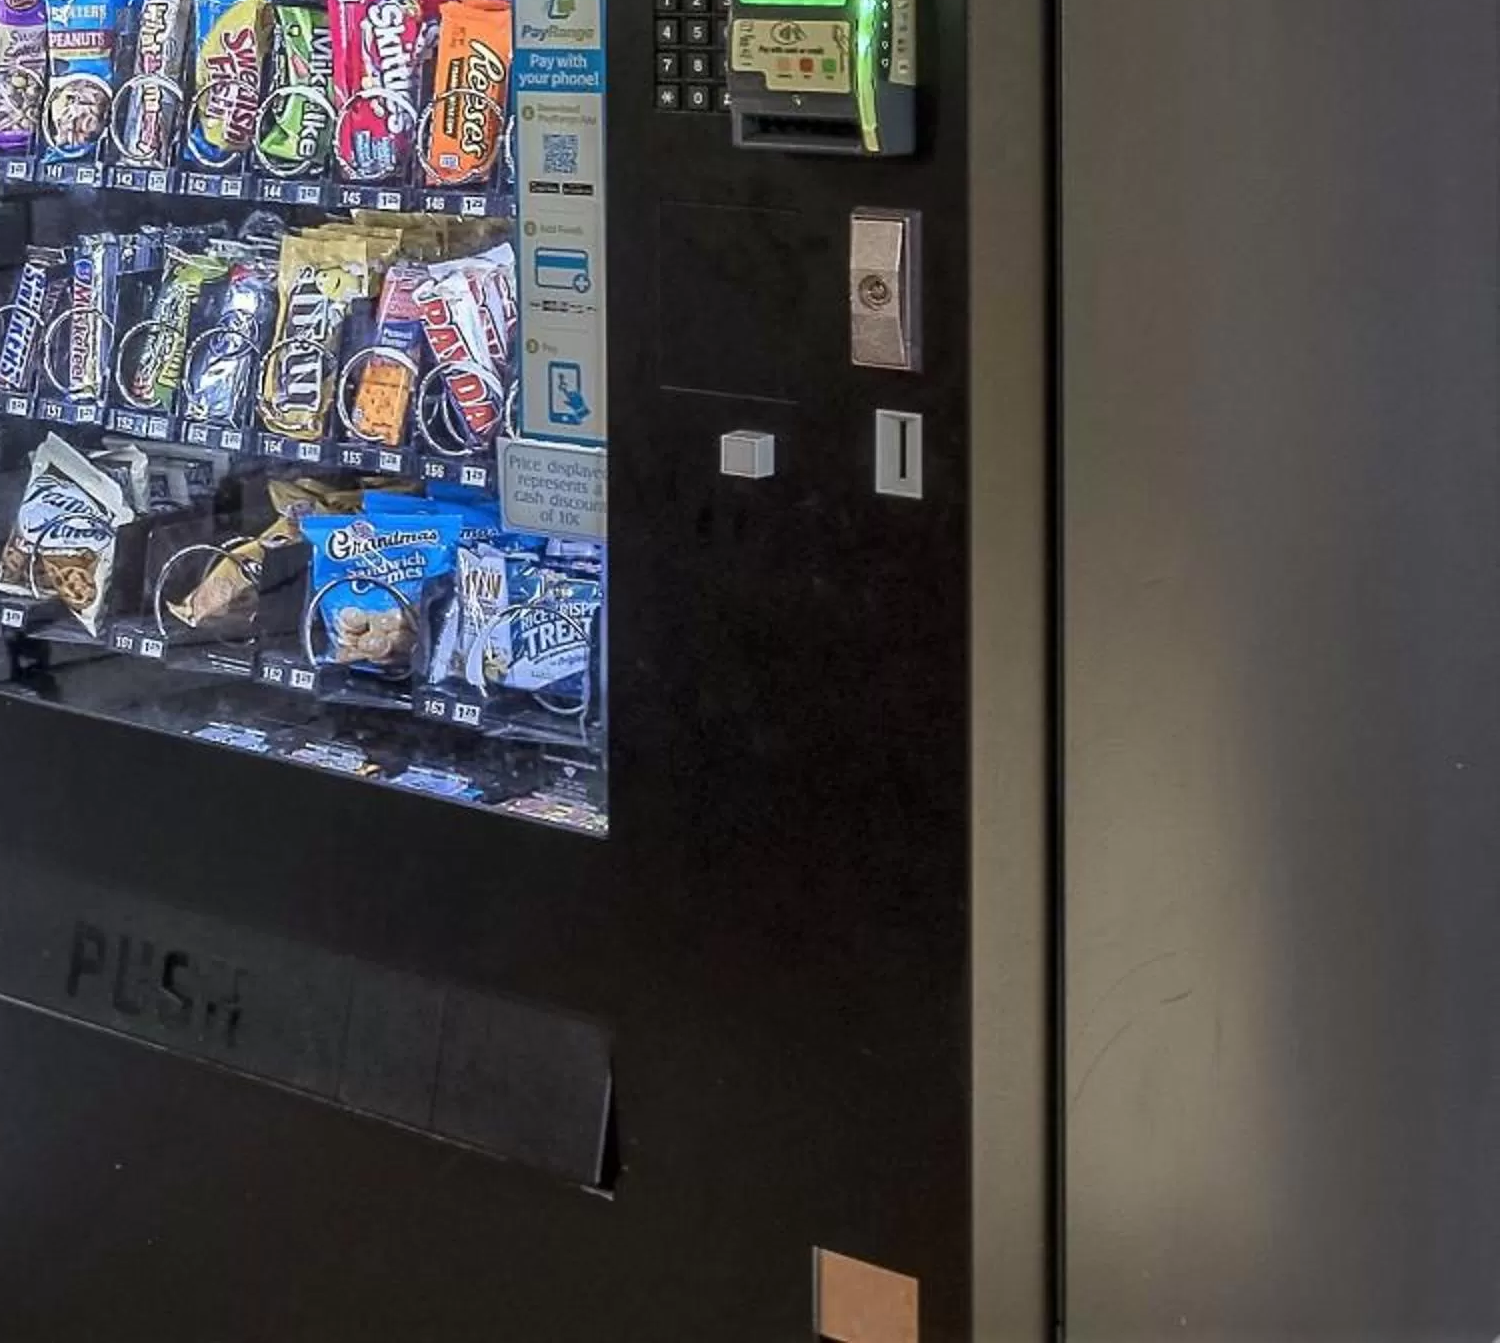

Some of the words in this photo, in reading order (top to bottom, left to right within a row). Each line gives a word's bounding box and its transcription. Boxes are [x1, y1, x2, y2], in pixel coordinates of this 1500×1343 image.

[49, 31, 105, 49] PEANUTS
[520, 24, 595, 41] PayRange
[661, 25, 671, 39] 4
[692, 26, 703, 39] 5
[367, 1, 414, 134] Skittls
[529, 54, 554, 69] Pay
[557, 54, 587, 68] with
[662, 58, 672, 72] 7
[692, 59, 703, 72] 8
[517, 74, 550, 88] your
[551, 71, 599, 87] phone!
[692, 91, 703, 105] 0
[263, 185, 281, 198] 144
[342, 190, 361, 204] 145
[343, 449, 361, 465] 155
[509, 454, 542, 472] Price
[547, 460, 604, 481] displaye
[518, 473, 588, 494] represents
[513, 489, 544, 505] cash
[549, 494, 605, 513] discoun
[540, 507, 555, 522] of
[351, 565, 424, 595] Cmes
[520, 610, 548, 631] RICE
[263, 666, 283, 681] 162
